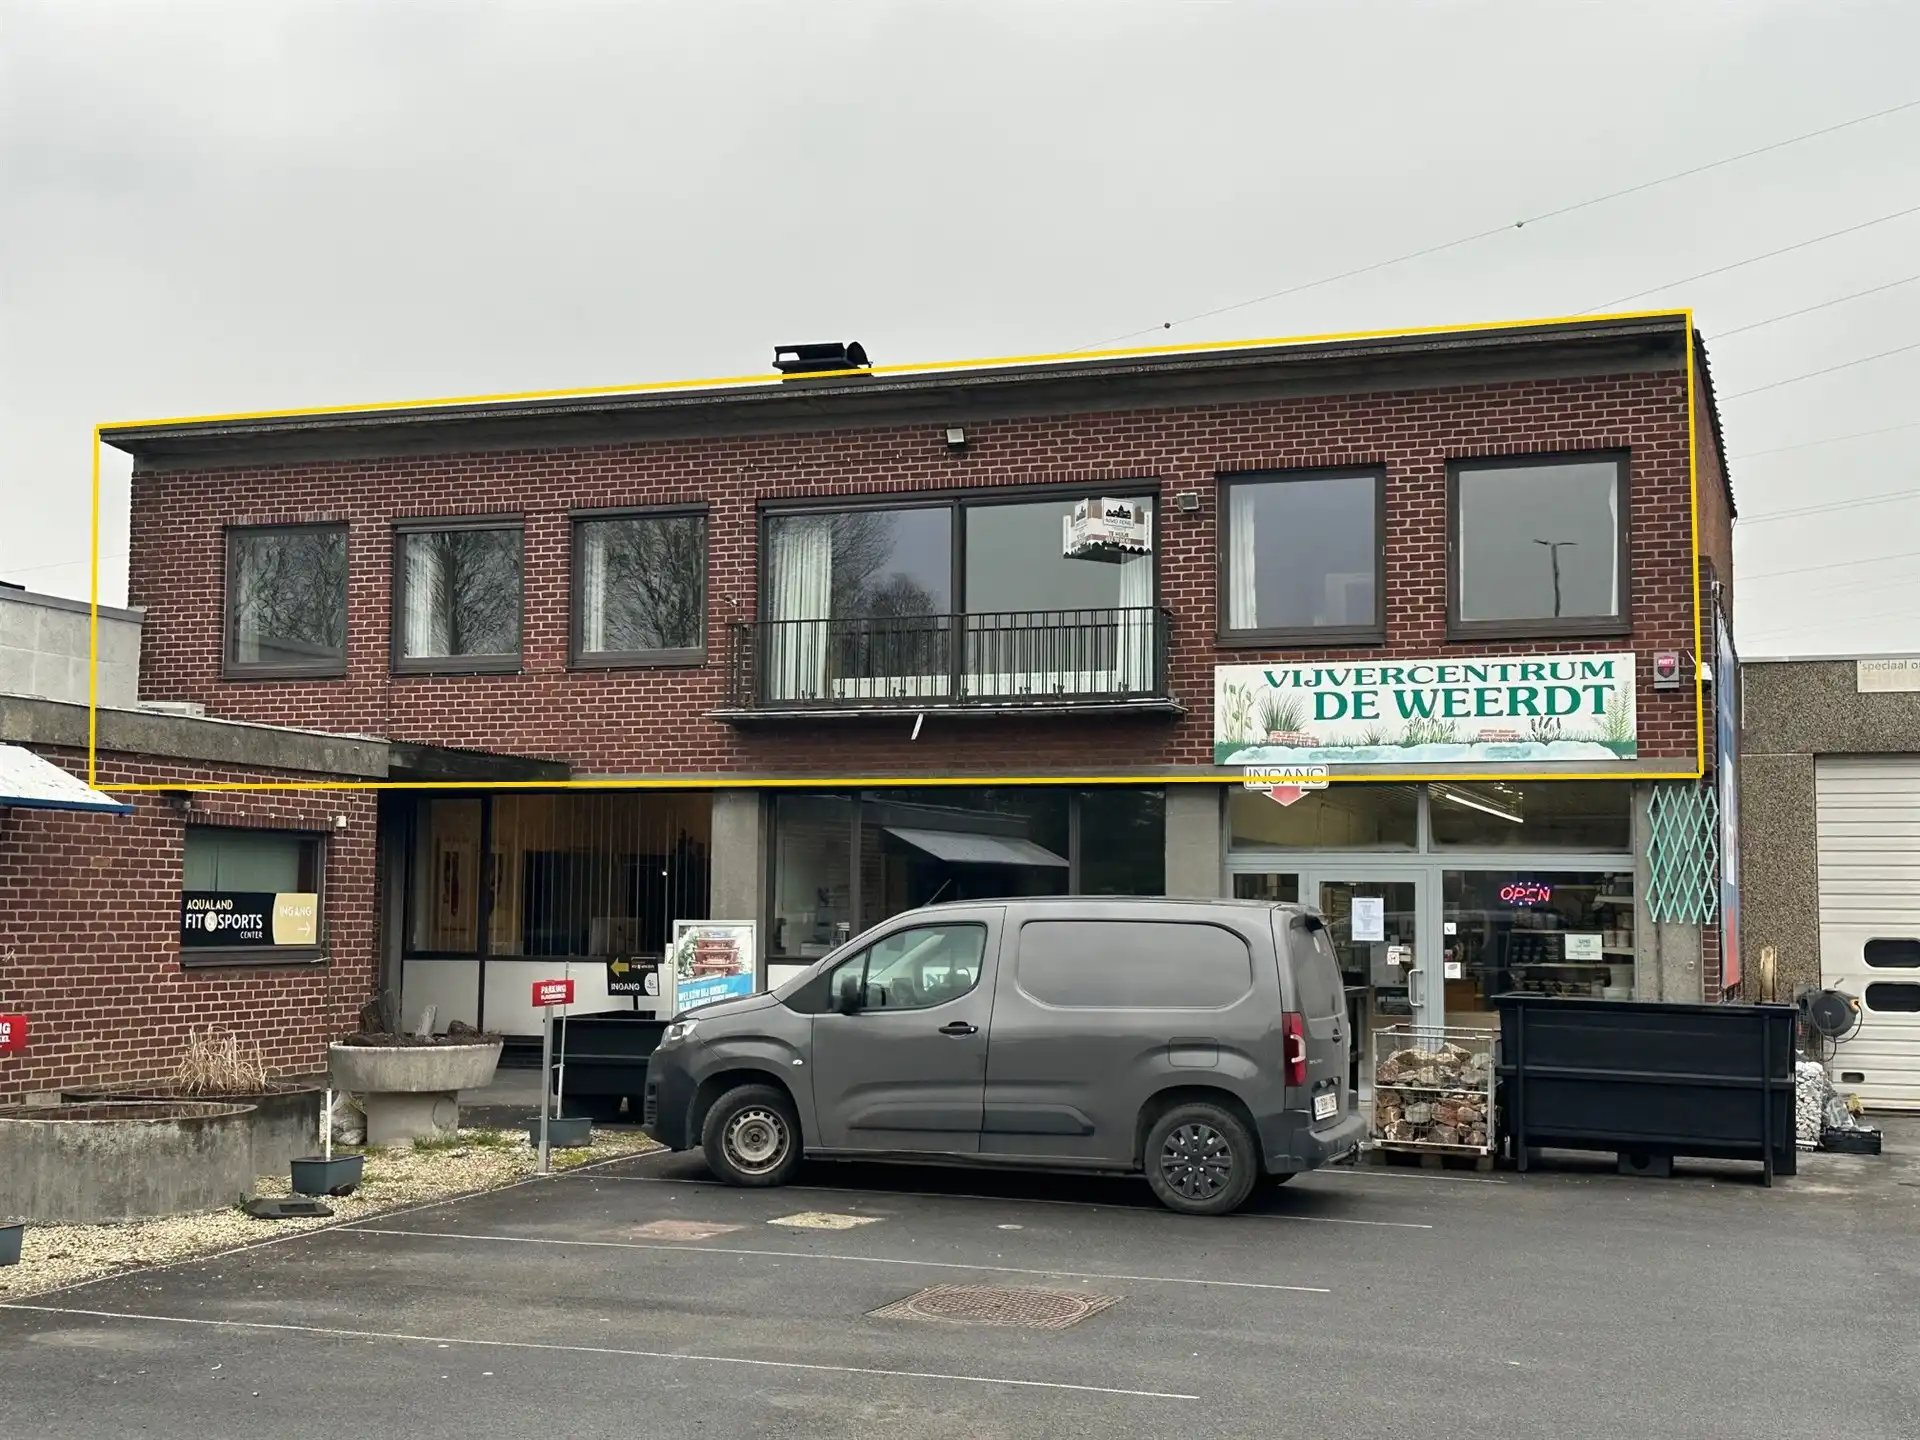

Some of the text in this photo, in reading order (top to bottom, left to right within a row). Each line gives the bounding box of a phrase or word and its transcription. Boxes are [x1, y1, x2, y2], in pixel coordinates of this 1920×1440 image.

[1263, 660, 1615, 688] VIJVERCENTRUM
[1313, 684, 1616, 720] DE WEERDT
[1500, 887, 1550, 902] OPEN
[186, 899, 233, 910] AQUALAND
[279, 906, 312, 917] INGANG
[240, 931, 263, 939] CENTER
